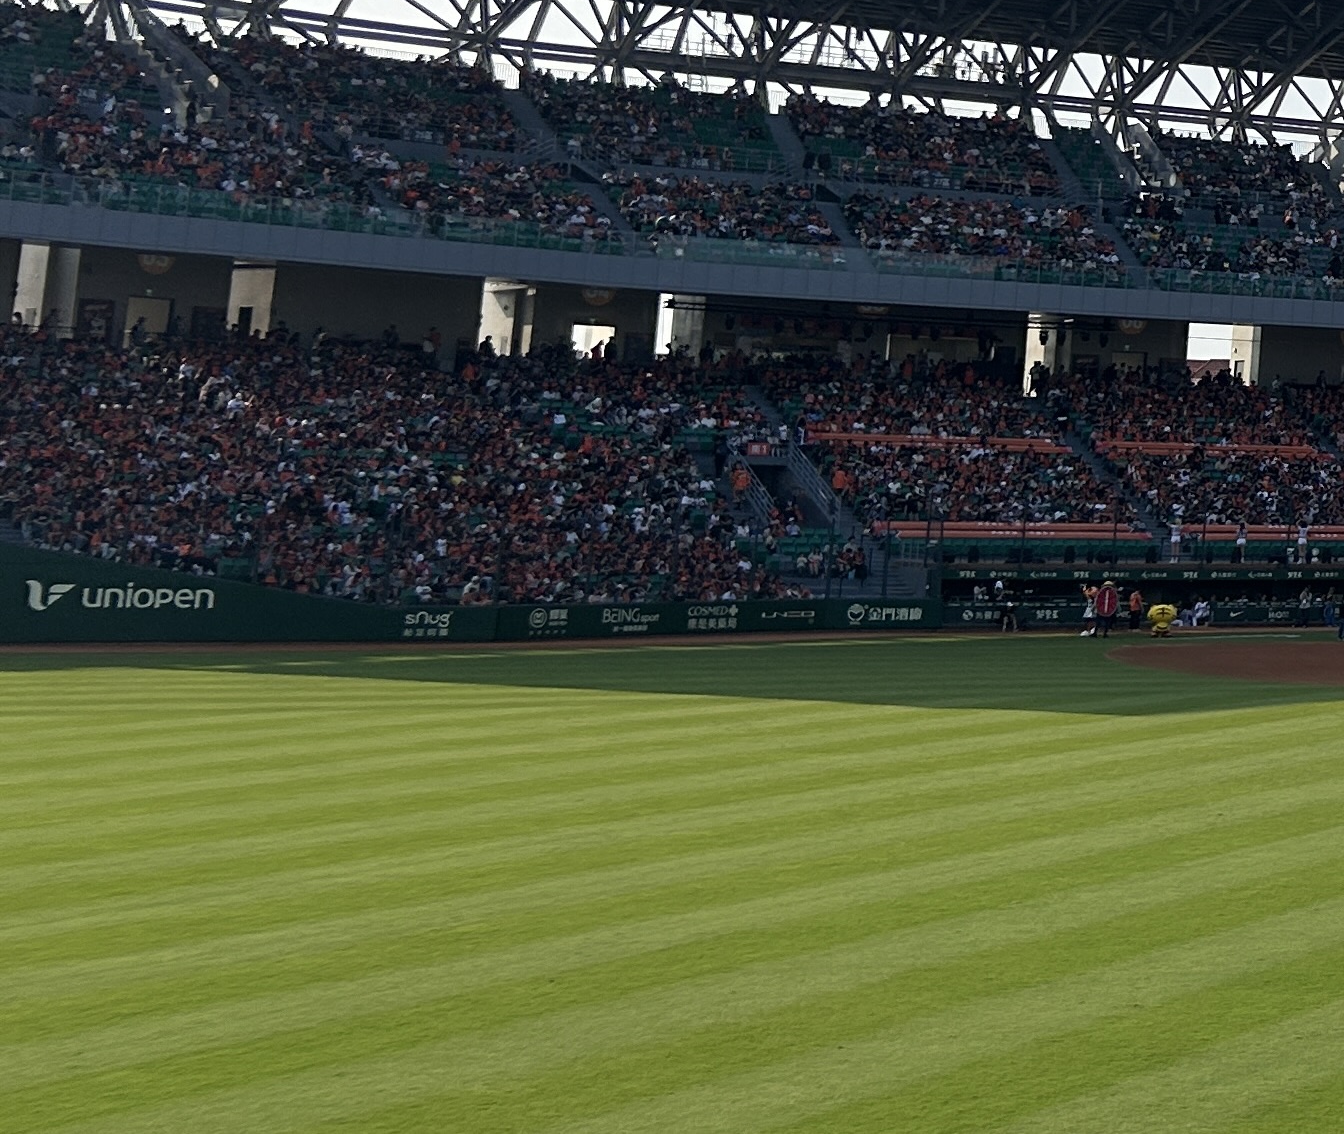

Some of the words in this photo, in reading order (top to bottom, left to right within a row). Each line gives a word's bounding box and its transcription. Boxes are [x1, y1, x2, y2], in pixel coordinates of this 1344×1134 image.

[81, 582, 215, 609] uniopen
[602, 608, 640, 623] BEING
[688, 606, 728, 616] COSMED
[404, 611, 450, 628] snug
